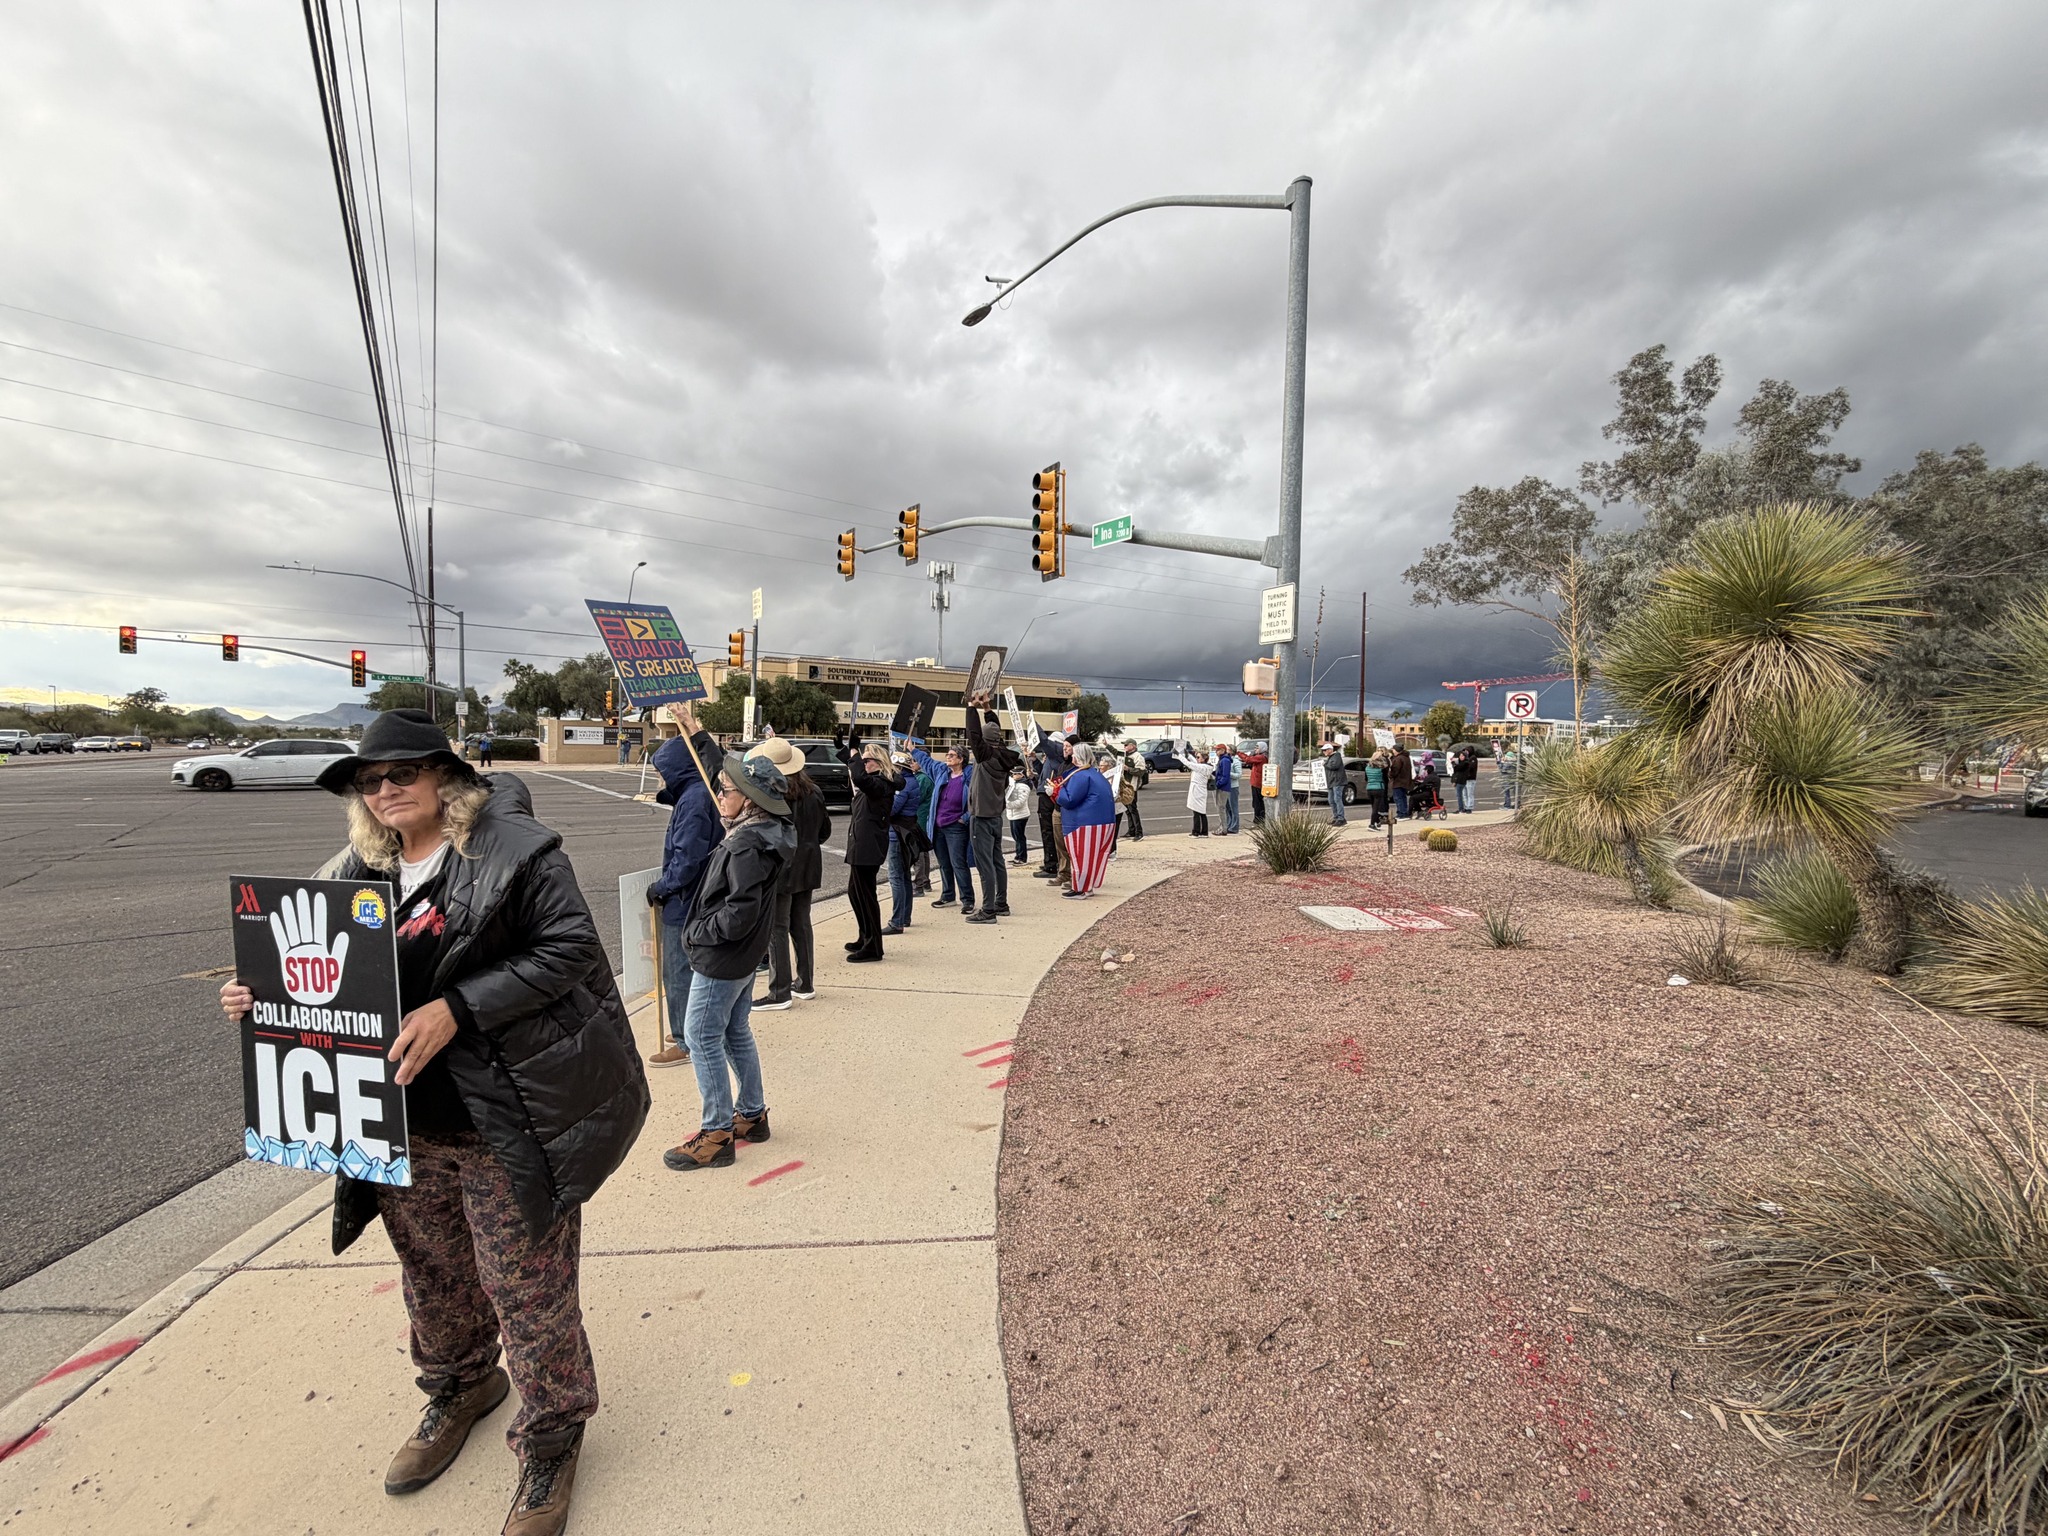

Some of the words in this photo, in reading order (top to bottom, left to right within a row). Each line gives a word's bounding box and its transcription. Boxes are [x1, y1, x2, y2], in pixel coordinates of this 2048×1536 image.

[1101, 527, 1112, 541] Ina
[1268, 592, 1287, 600] TURNING
[1268, 601, 1287, 609] TRAFFIC
[1268, 610, 1285, 619] MUST
[1266, 620, 1279, 628] YIELD
[1261, 628, 1291, 637] PEDESTRIANS
[607, 640, 685, 659] EQUALITY
[617, 661, 635, 678] IS
[635, 658, 697, 677] GREATER
[828, 667, 861, 675] SOUTHERN
[863, 669, 890, 678] ARIZONA
[625, 679, 659, 692] THAN
[659, 674, 702, 690] DIVISION
[866, 676, 890, 684] THROAT
[844, 711, 866, 719] SIUS
[359, 903, 378, 917] ICE
[240, 914, 268, 922] MARRIOTT
[285, 956, 340, 993] STOP
[253, 1001, 382, 1039] COLLABORATION
[300, 1032, 333, 1049] WITH
[255, 1042, 391, 1163] ICE
